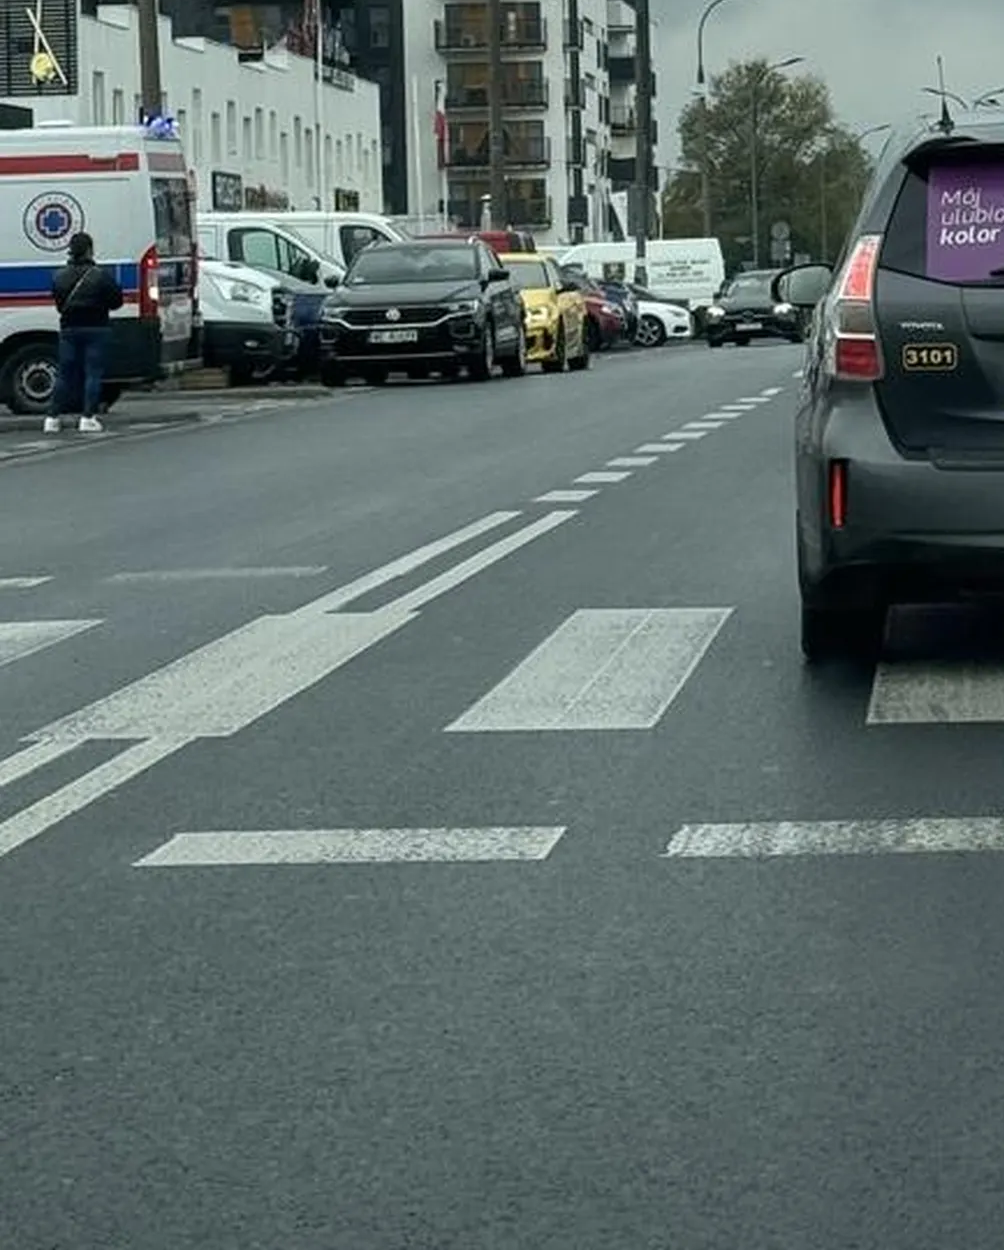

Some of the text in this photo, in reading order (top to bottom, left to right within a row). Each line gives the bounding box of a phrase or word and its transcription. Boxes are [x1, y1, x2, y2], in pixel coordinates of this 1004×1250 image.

[941, 188, 982, 208] Mój
[940, 226, 1001, 245] kolor
[906, 349, 953, 364] 3101
